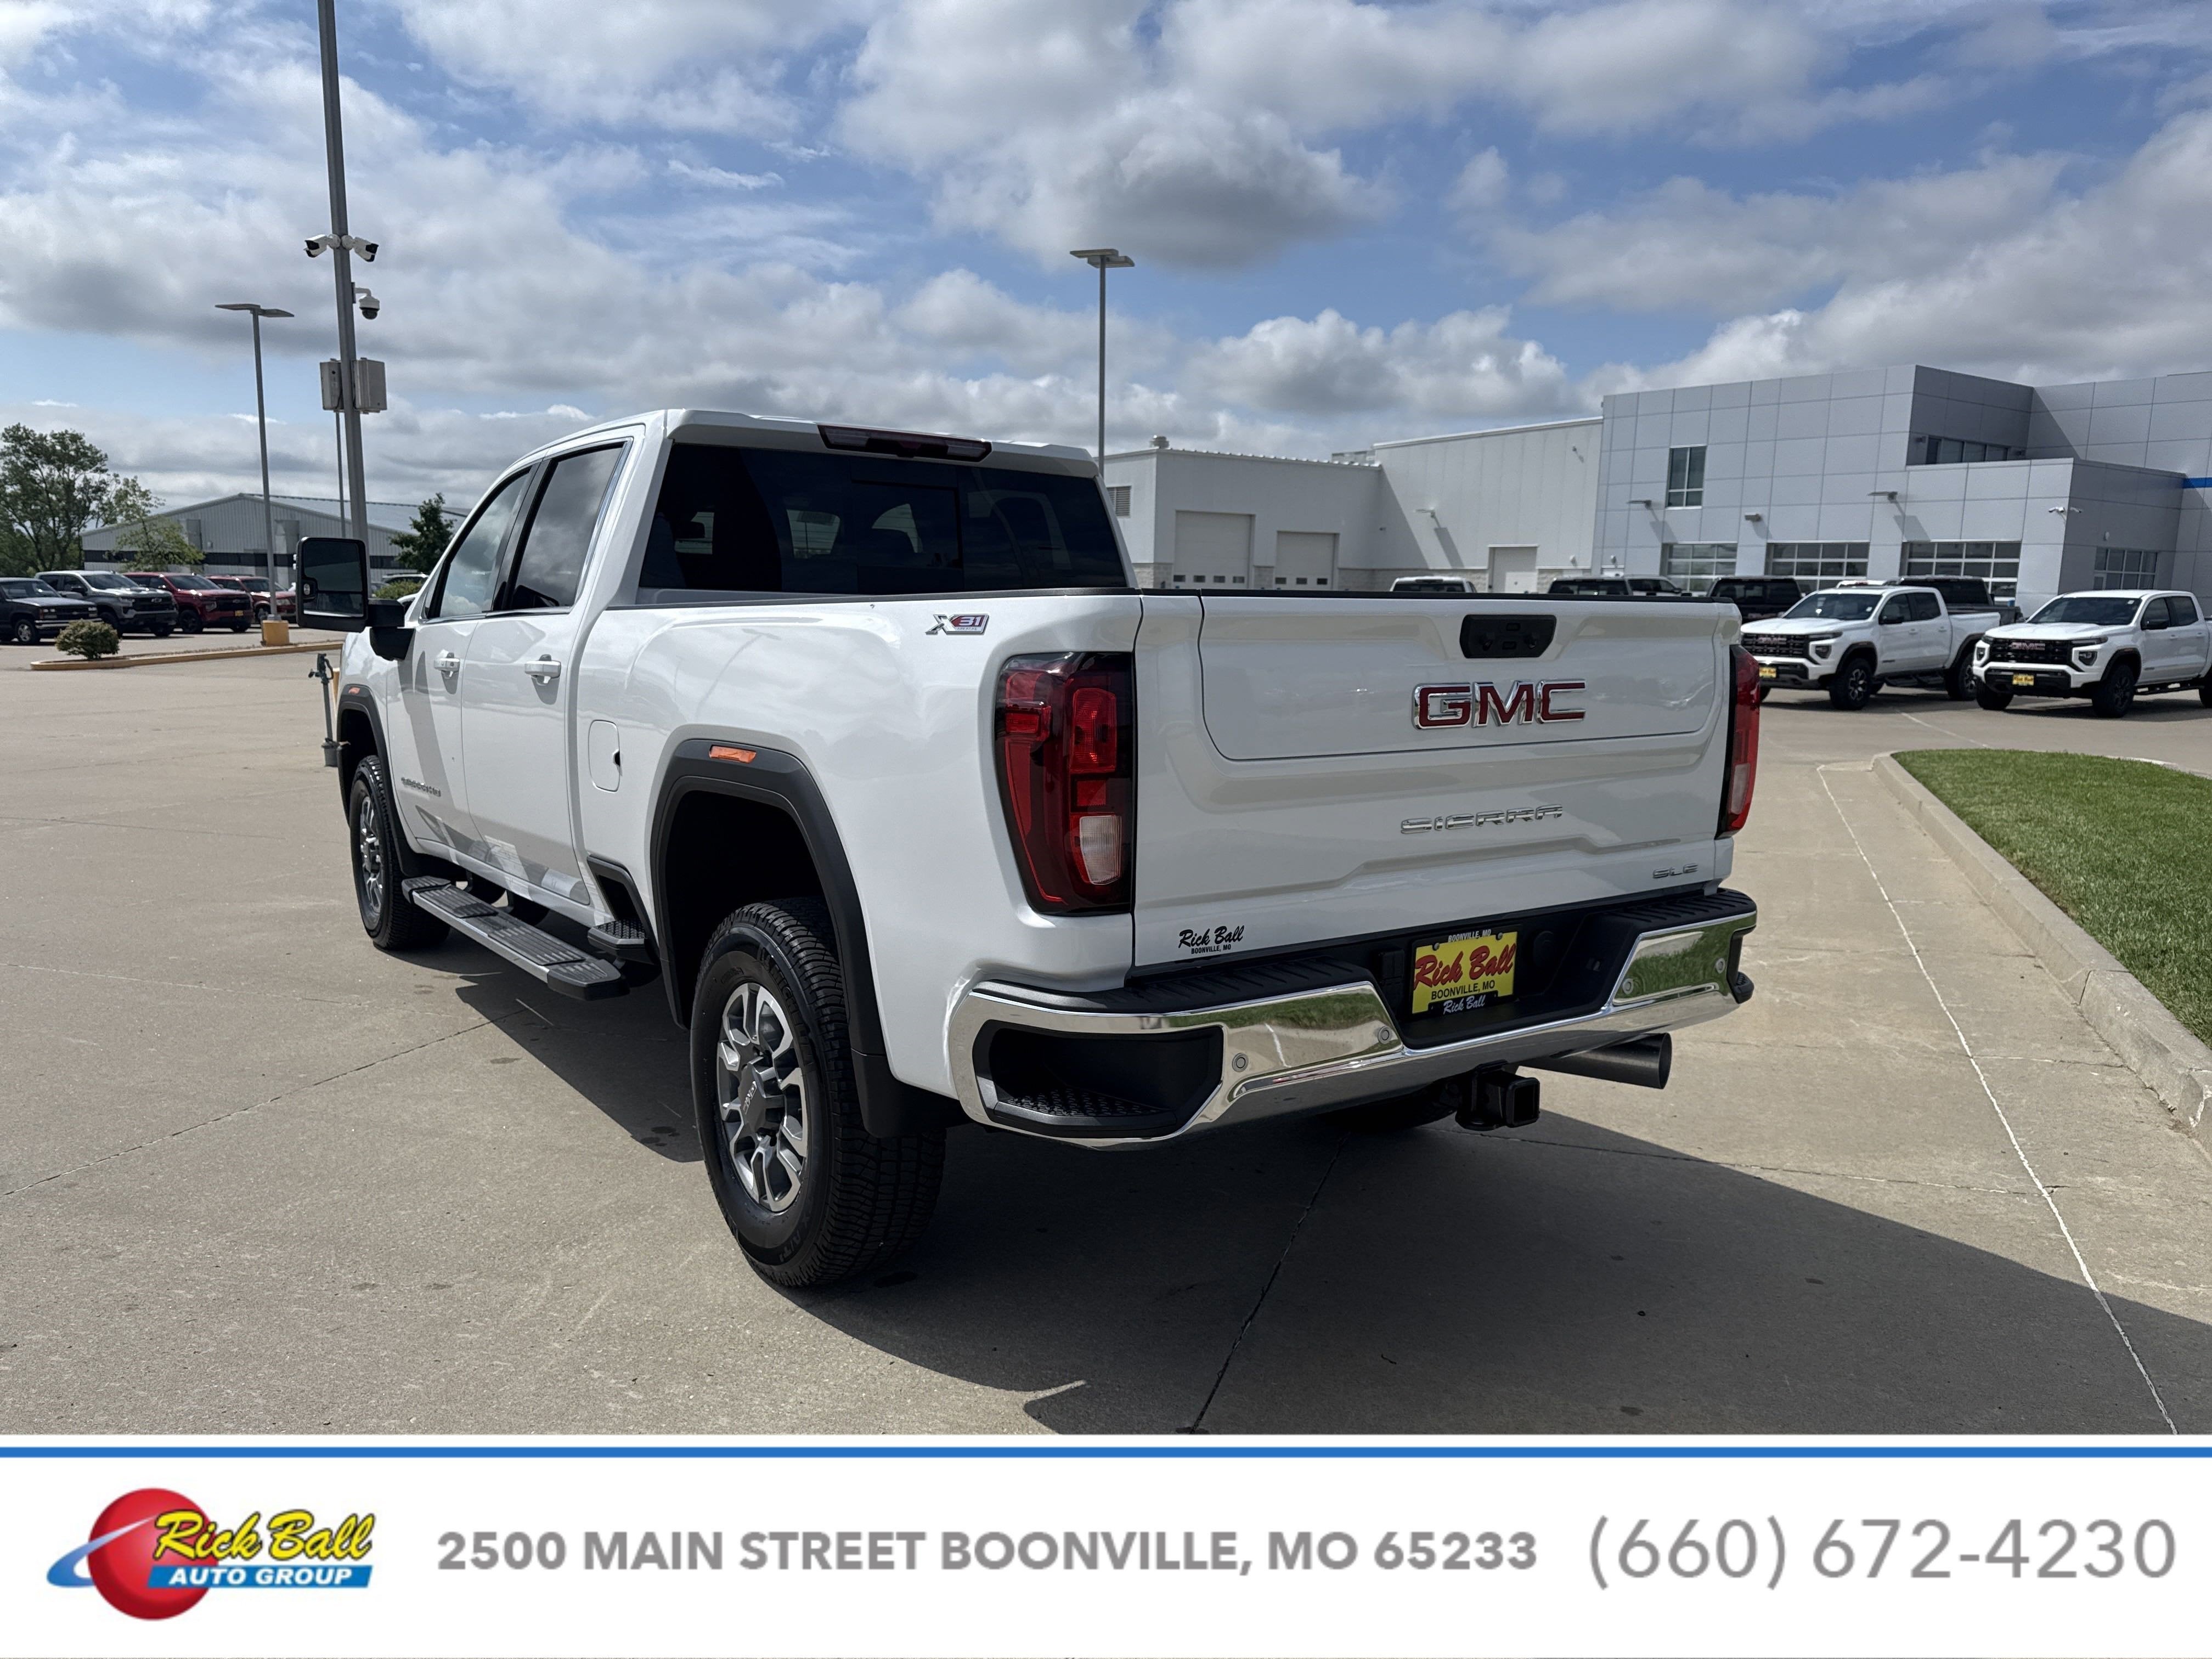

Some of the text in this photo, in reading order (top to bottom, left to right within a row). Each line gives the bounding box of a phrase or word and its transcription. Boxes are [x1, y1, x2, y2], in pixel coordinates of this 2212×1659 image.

[926, 613, 989, 635] X31
[2010, 642, 2046, 651] GMC
[1413, 679, 1586, 730] GMC
[1401, 804, 1563, 834] SIERRA
[1652, 863, 1699, 879] SLE
[1178, 925, 1245, 948] Rick Ball
[1448, 931, 1480, 942] BOONVILLE,
[1191, 945, 1222, 954] BOONVILLE,
[1413, 943, 1517, 990] Rick Ball
[1431, 980, 1495, 1000] BOONVILLE, MO
[1443, 995, 1486, 1014] Rick Ball
